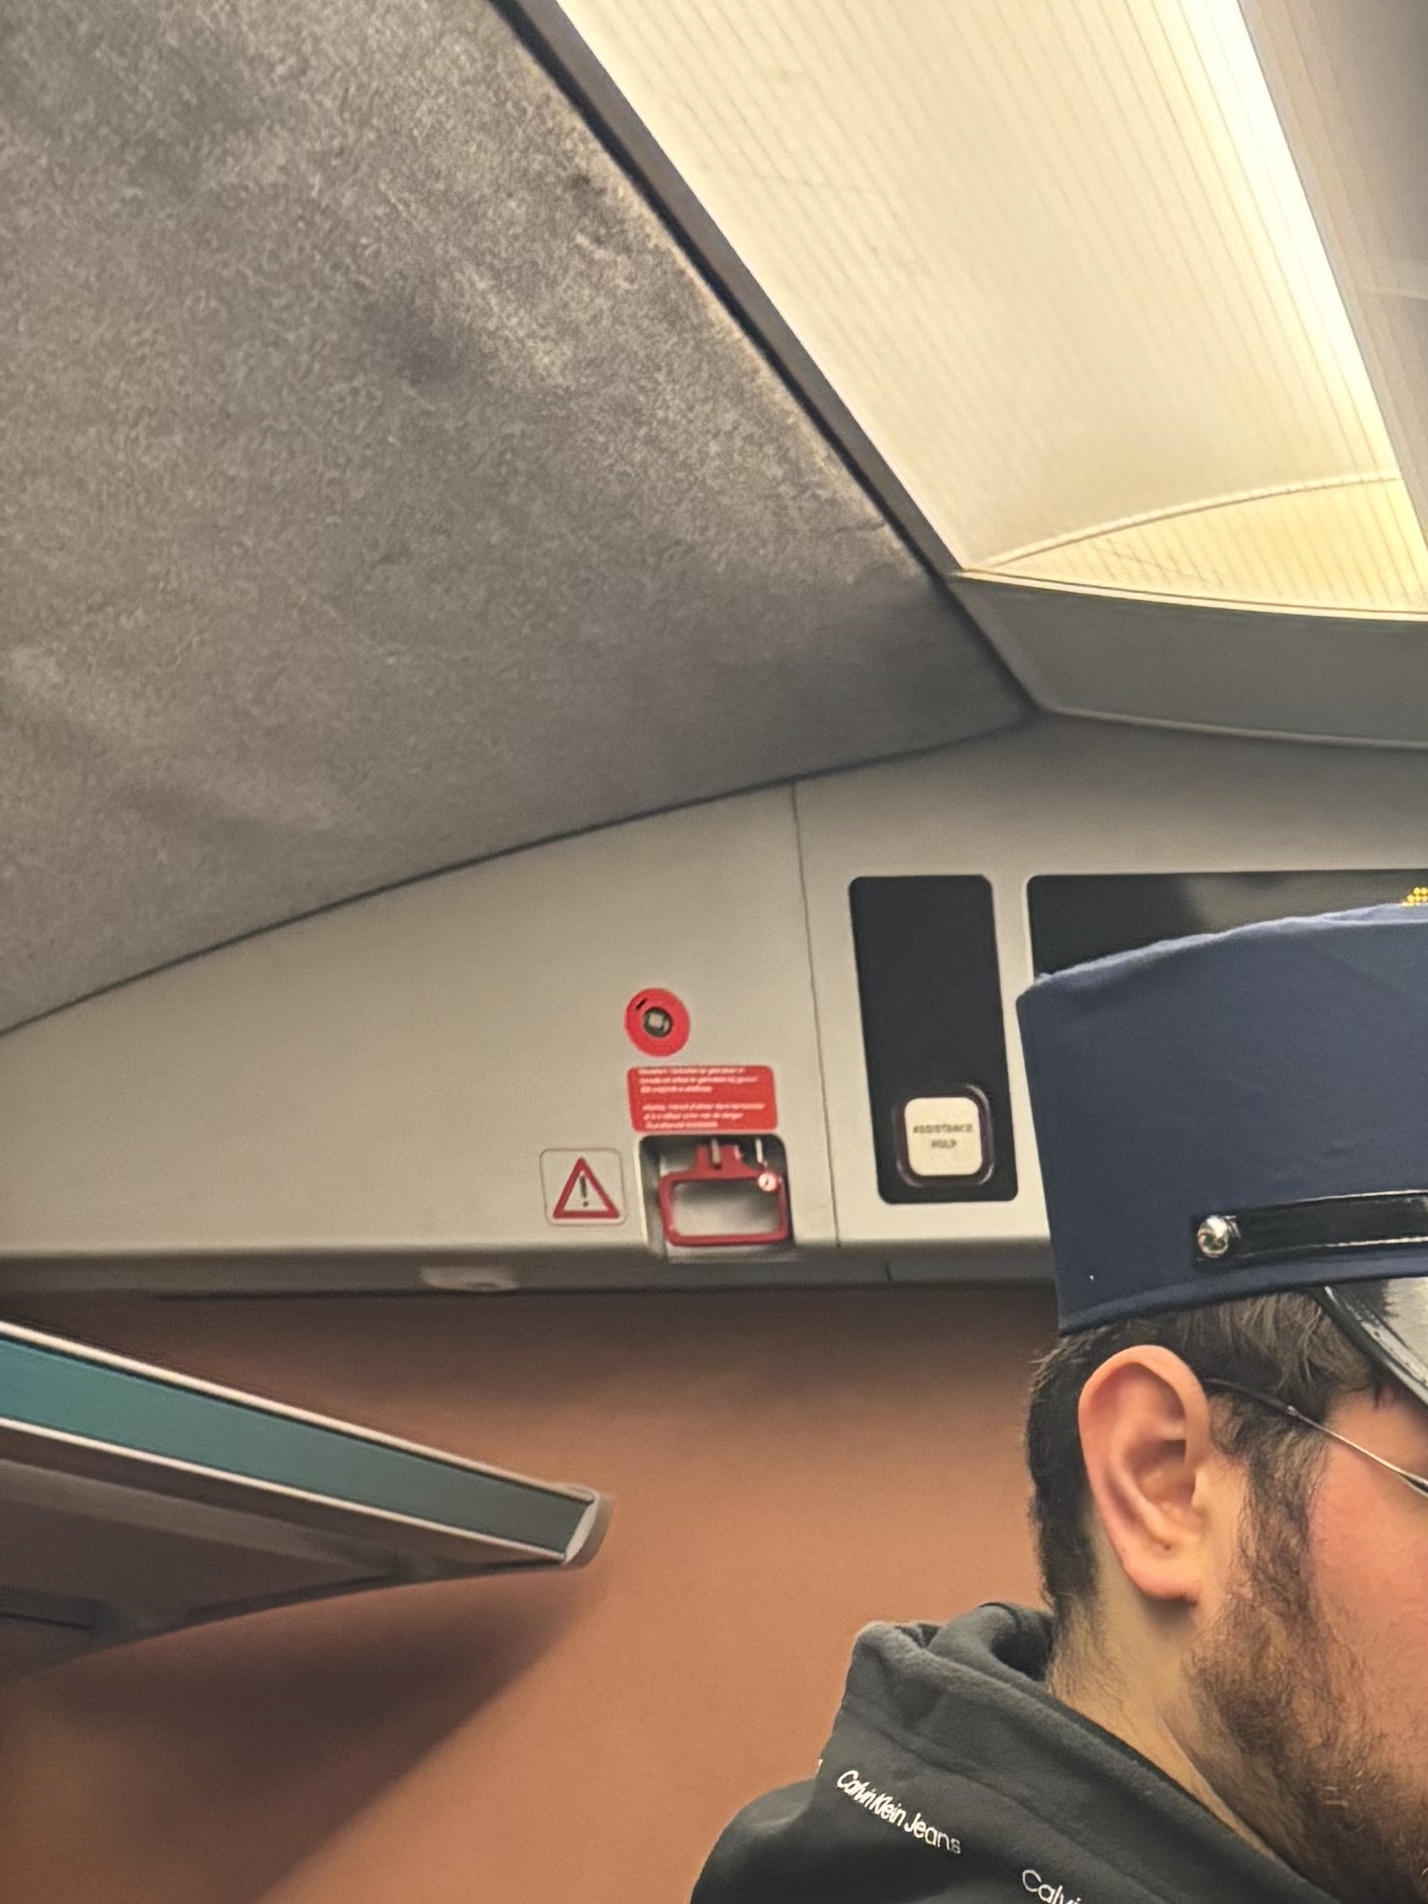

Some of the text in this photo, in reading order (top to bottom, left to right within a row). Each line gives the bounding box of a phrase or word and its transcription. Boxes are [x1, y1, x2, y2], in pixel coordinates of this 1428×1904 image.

[837, 1770, 961, 1854] Calvin Klein Jeans
